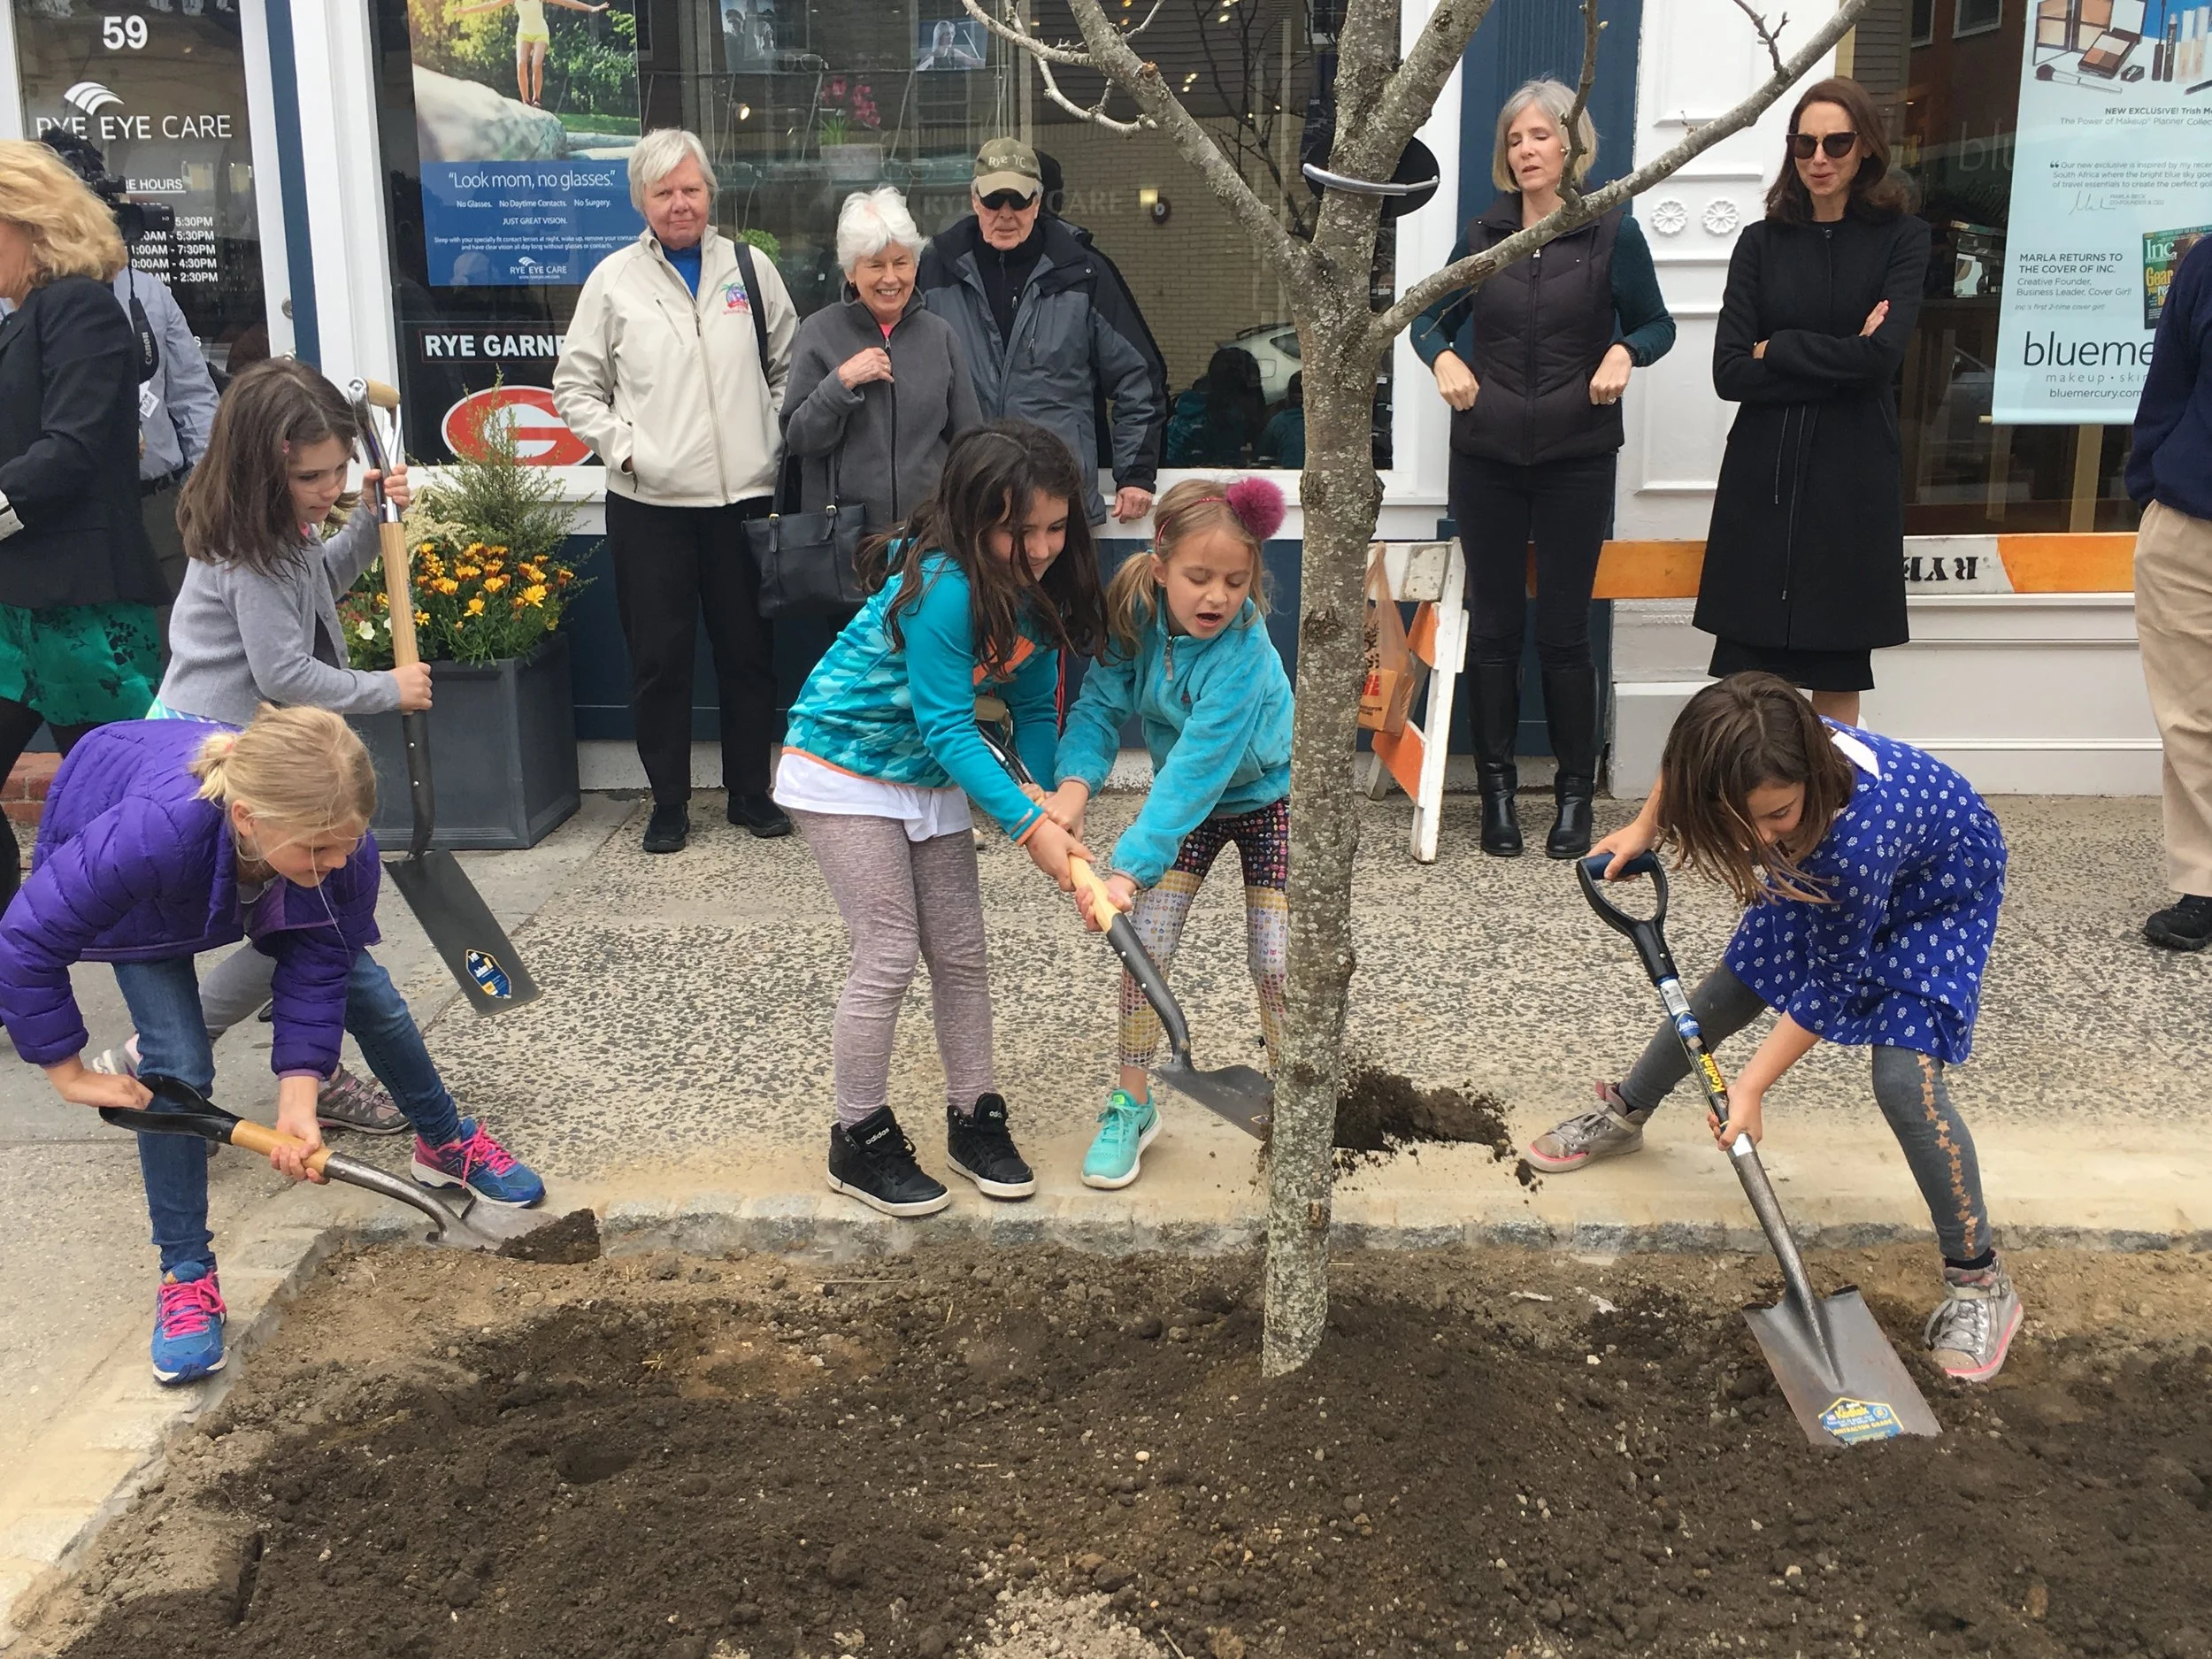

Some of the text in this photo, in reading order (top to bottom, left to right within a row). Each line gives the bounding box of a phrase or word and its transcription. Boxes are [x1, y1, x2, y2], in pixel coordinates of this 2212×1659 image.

[103, 15, 148, 50] 59
[100, 115, 151, 140] EYE
[162, 114, 233, 140] CARE
[988, 154, 1026, 169] Rye YC
[2140, 171, 2162, 180] bright
[139, 178, 183, 190] HOURS
[492, 173, 535, 190] mom,
[538, 173, 557, 188] no
[467, 199, 493, 208] Glasses.
[510, 199, 536, 209] Daytime
[585, 198, 611, 208] Surgery.
[175, 216, 213, 227] 5:30PM
[176, 230, 214, 241] 5:30PM
[125, 244, 168, 255] 1:00AM
[177, 244, 216, 255] 7:30PM
[131, 258, 169, 268] 0:00AM
[179, 257, 217, 268] 4:30PM
[2019, 253, 2123, 262] MARLA RETURNS TO
[510, 265, 567, 274] RYE EYE CARE
[2019, 265, 2116, 273] THE COVER OF INC.
[180, 272, 219, 282] 2:30PM
[2088, 288, 2113, 296] Cover
[425, 334, 476, 357] RYE
[2046, 373, 2105, 384] makeup
[2049, 388, 2142, 399] bluemercury.com
[1700, 1053, 1725, 1094] Kodiak
[864, 1126, 890, 1145] adidas
